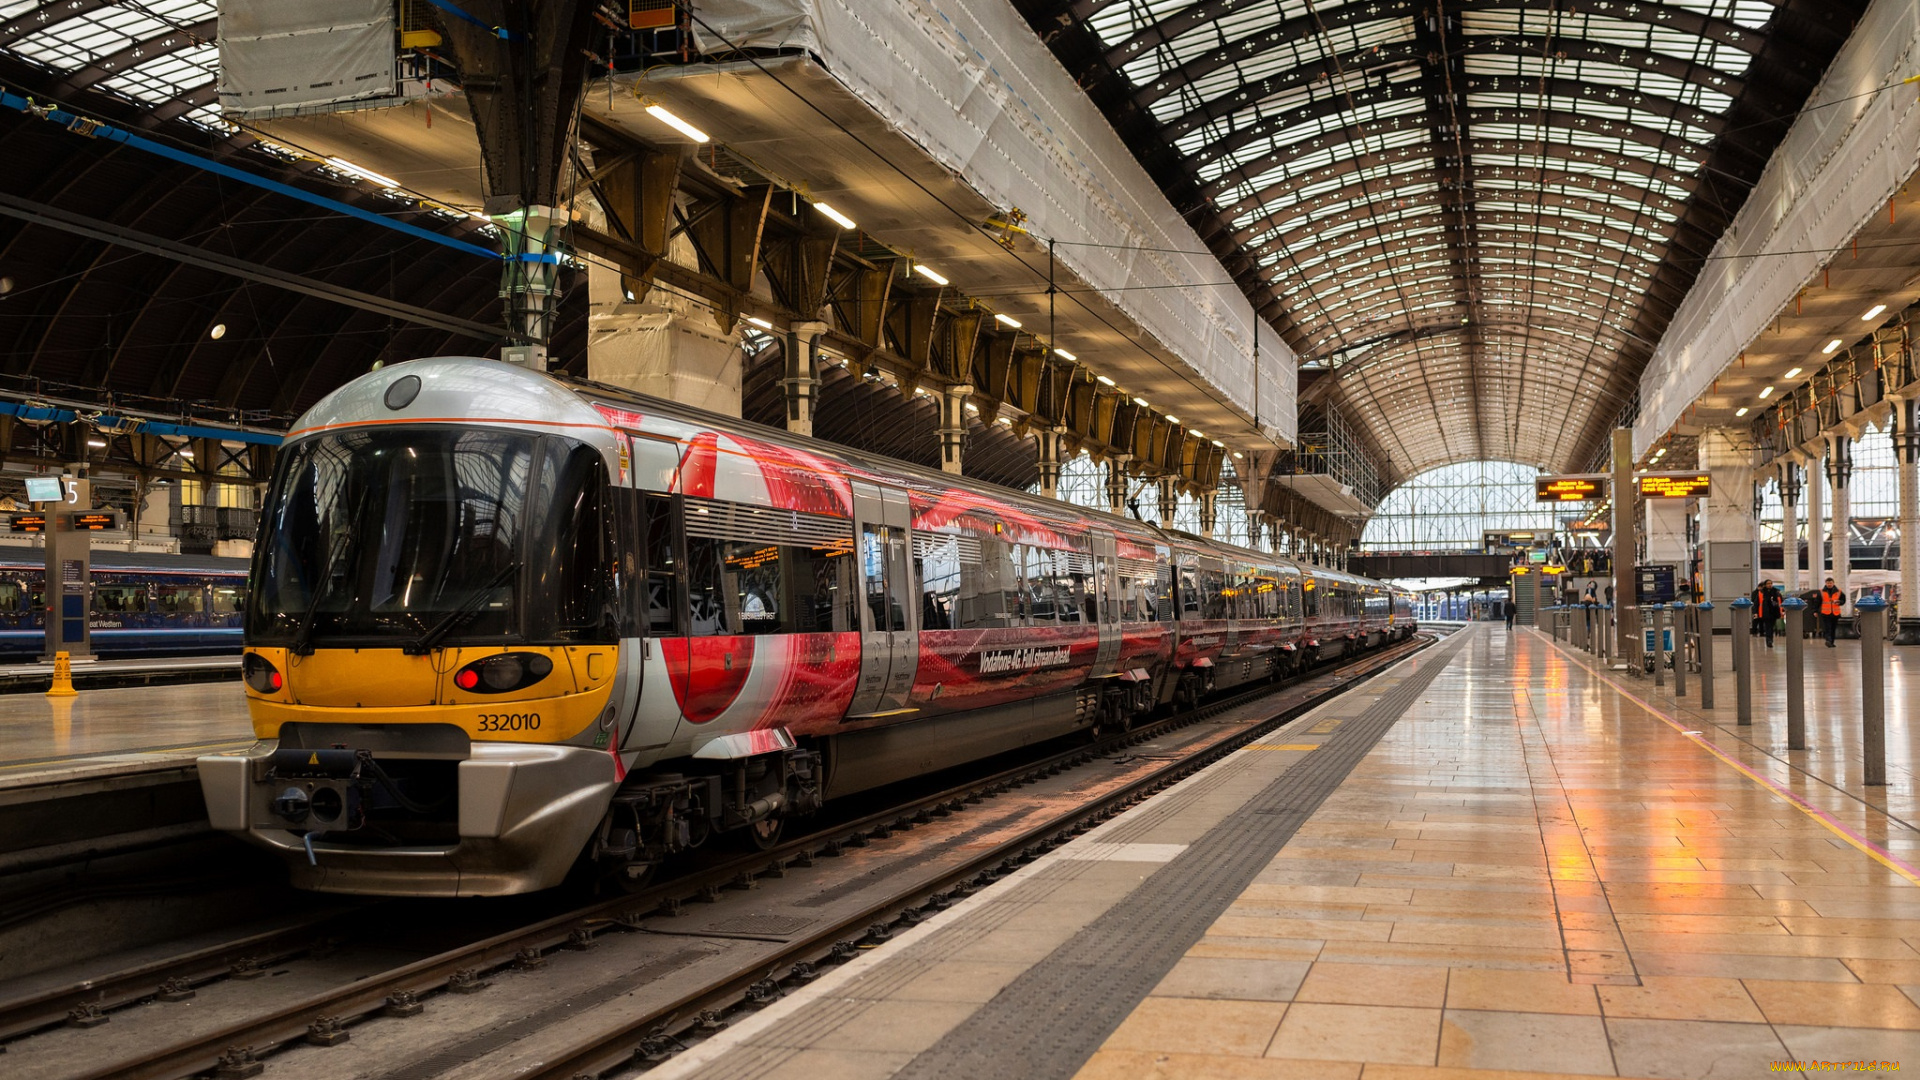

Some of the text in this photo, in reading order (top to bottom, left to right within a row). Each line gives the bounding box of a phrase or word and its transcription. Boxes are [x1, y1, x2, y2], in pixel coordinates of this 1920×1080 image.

[68, 481, 78, 504] 5
[99, 620, 122, 628] Western
[979, 645, 1071, 673] Vodafone 4G. Full stream ahead.
[477, 712, 541, 732] 332010
